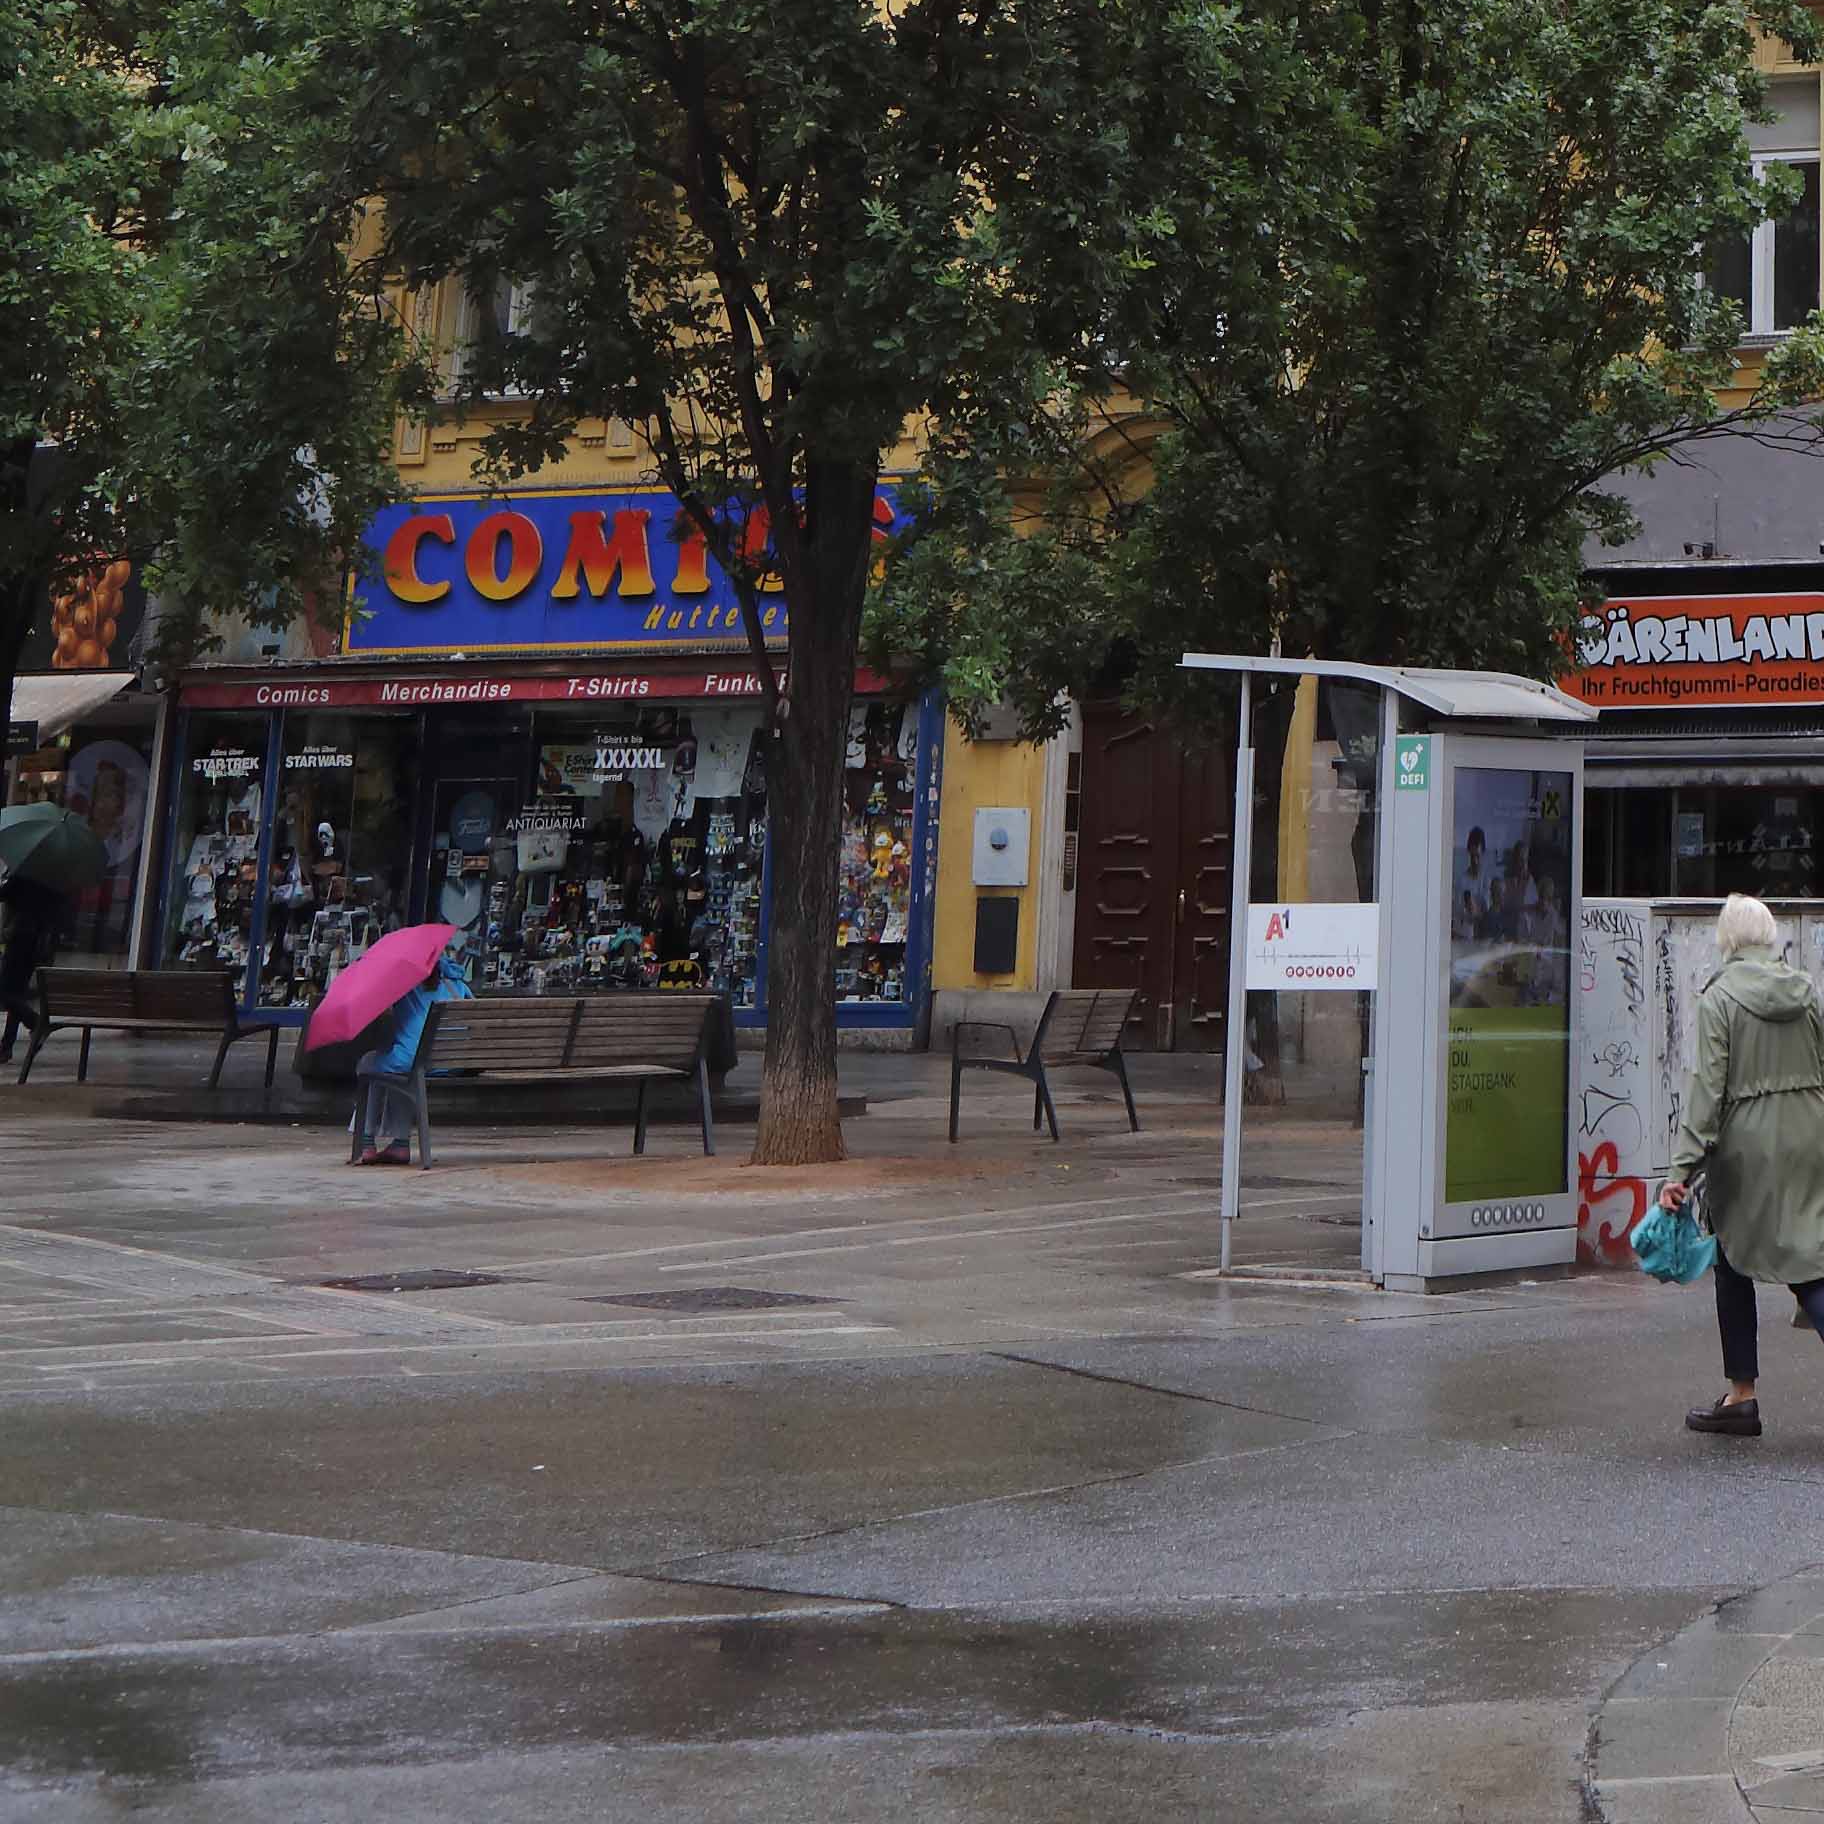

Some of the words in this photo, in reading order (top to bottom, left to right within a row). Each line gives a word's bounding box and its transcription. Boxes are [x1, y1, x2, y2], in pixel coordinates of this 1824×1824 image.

[384, 507, 896, 604] COMI
[642, 603, 792, 631] Huttee
[256, 685, 330, 704] Comics
[381, 680, 512, 701] Merchandise
[567, 677, 650, 697] T-Shirts
[1581, 676, 1606, 696] Ihr
[1400, 773, 1425, 785] DEFI
[505, 816, 588, 831] ANTIQUARIAT
[1265, 909, 1291, 941] A1
